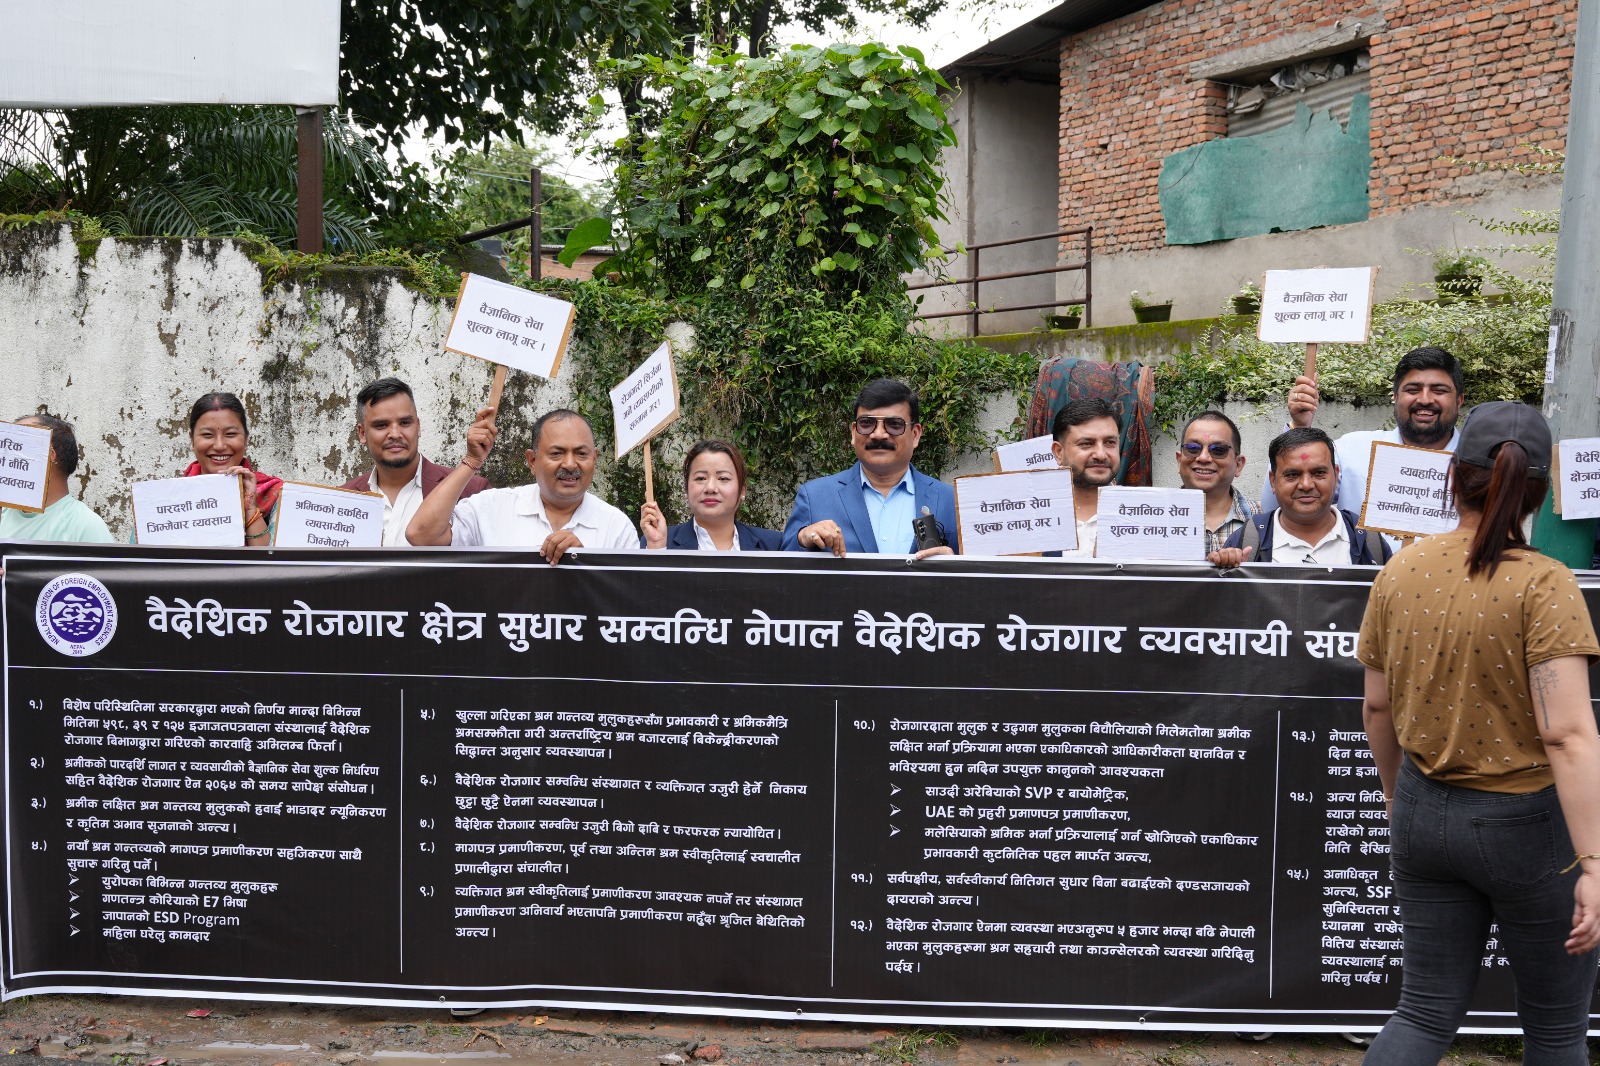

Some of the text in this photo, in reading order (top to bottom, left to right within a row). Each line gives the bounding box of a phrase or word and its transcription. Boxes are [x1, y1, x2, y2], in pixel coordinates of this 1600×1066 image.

[1283, 291, 1348, 304] वैज्ञानिक सेवा
[479, 302, 544, 331] वैज्ञानिक सेवा
[1274, 311, 1301, 323] शुल्क
[1304, 310, 1327, 322] लागू
[466, 319, 494, 336] शुल्क
[495, 329, 519, 347] लागू
[8, 459, 30, 471] नीति
[1575, 451, 1600, 463] वैदेशि
[1388, 483, 1430, 500] न्यायपूर्ण
[1580, 488, 1600, 500] उचि
[195, 497, 218, 510] नीति
[295, 500, 369, 520] श्रमिकको हकहित
[980, 496, 1051, 514] वैज्ञानिक सेवा
[1118, 503, 1190, 517] वैज्ञानिक सेवा
[1376, 500, 1420, 516] सम्मानित
[146, 515, 232, 533] जिम्मेवार व्यवसाय
[305, 518, 356, 534] व्यवसायीको
[973, 521, 1003, 536] शुल्क
[1007, 518, 1033, 531] लागू
[1110, 525, 1140, 537] शुल्क
[1143, 526, 1169, 538] लागू
[39, 577, 114, 646] NEPAL ASSOCIATION OF FOREIGN EMPLOYMENT AGENCIES
[145, 596, 271, 638] वैदेशिक
[283, 600, 408, 637] रोजगार
[420, 602, 486, 644] क्षेत्र
[498, 613, 587, 646] सुधार
[744, 609, 843, 648] नेपाल
[854, 610, 985, 654] वैदेशिक
[997, 614, 1127, 653] रोजगार
[1139, 620, 1292, 656] व्यवसायी
[1304, 622, 1361, 659] संघ
[94, 699, 155, 712] परिस्थितिमा
[159, 703, 217, 716] सरकारद्वारा
[220, 702, 251, 714] भएको
[254, 702, 285, 714] निर्णय
[148, 761, 177, 771] लागत
[180, 762, 187, 771] र
[190, 760, 245, 772] व्यवसायीको
[291, 762, 310, 773] सेवा
[314, 765, 339, 778] शुल्क
[342, 763, 379, 775] निर्धारण
[455, 773, 496, 787] वैदेशिक
[500, 774, 542, 786] रोजगार
[592, 776, 641, 789] संस्थागत
[644, 781, 652, 790] र
[656, 780, 705, 793] व्यक्तिगत
[709, 781, 739, 797] उजुरी
[769, 782, 807, 794] निकाय
[925, 784, 960, 798] साउदी
[1025, 787, 1052, 798] SVP
[1057, 789, 1065, 798] र
[1327, 793, 1356, 802] अन्य
[926, 806, 955, 818] UAE
[959, 805, 974, 817] को
[978, 806, 1006, 820] प्रहरी
[1009, 809, 1059, 820] प्रमाणपत्र
[925, 825, 987, 838] मलेसियाको
[991, 826, 1025, 838] श्रमिक
[1029, 827, 1053, 839] भर्ना
[1055, 827, 1118, 842] प्रक्रियालाई
[1121, 829, 1142, 841] गर्न
[1144, 830, 1197, 843] खोजिएको
[1326, 824, 1364, 836] राखेको
[102, 874, 143, 889] युरोपका
[189, 880, 227, 889] गन्तव्य
[1010, 873, 1055, 886] नितिगत
[1059, 877, 1089, 890] सुधार
[102, 894, 145, 904] गणतन्त्र
[149, 893, 199, 906] कोरियाको
[204, 896, 219, 907] E7
[455, 885, 503, 897] व्यक्तिगत
[506, 887, 525, 896] श्रम
[592, 887, 652, 899] प्रमाणीकरण
[655, 892, 703, 902] आवश्यक
[736, 896, 752, 905] तर
[755, 895, 803, 907] संस्थागत
[1365, 885, 1393, 899] SSF
[102, 909, 239, 927] जापानको ESD Program
[103, 926, 210, 943] महिला घरेलु कामदार
